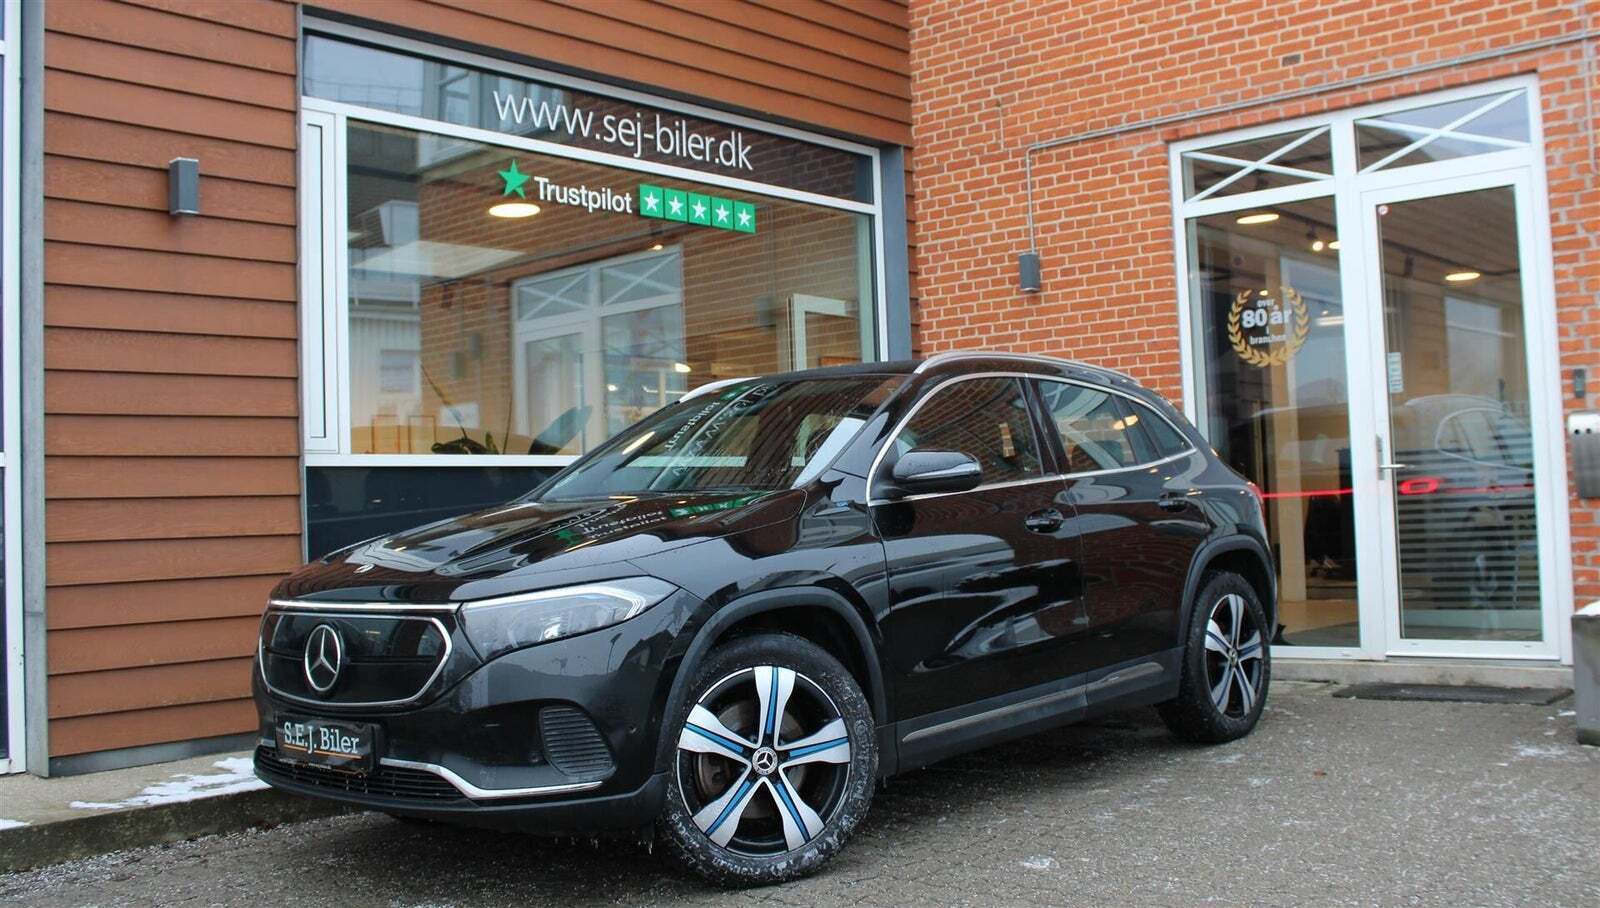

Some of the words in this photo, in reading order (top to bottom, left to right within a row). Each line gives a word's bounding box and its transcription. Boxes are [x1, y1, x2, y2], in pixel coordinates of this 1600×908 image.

[493, 91, 754, 170] www.sej-biler.dk
[534, 176, 633, 214] Trustpilot
[1242, 309, 1267, 328] 80
[1270, 305, 1292, 324] år
[284, 721, 317, 754] S.E.J.
[320, 727, 360, 754] Biler
